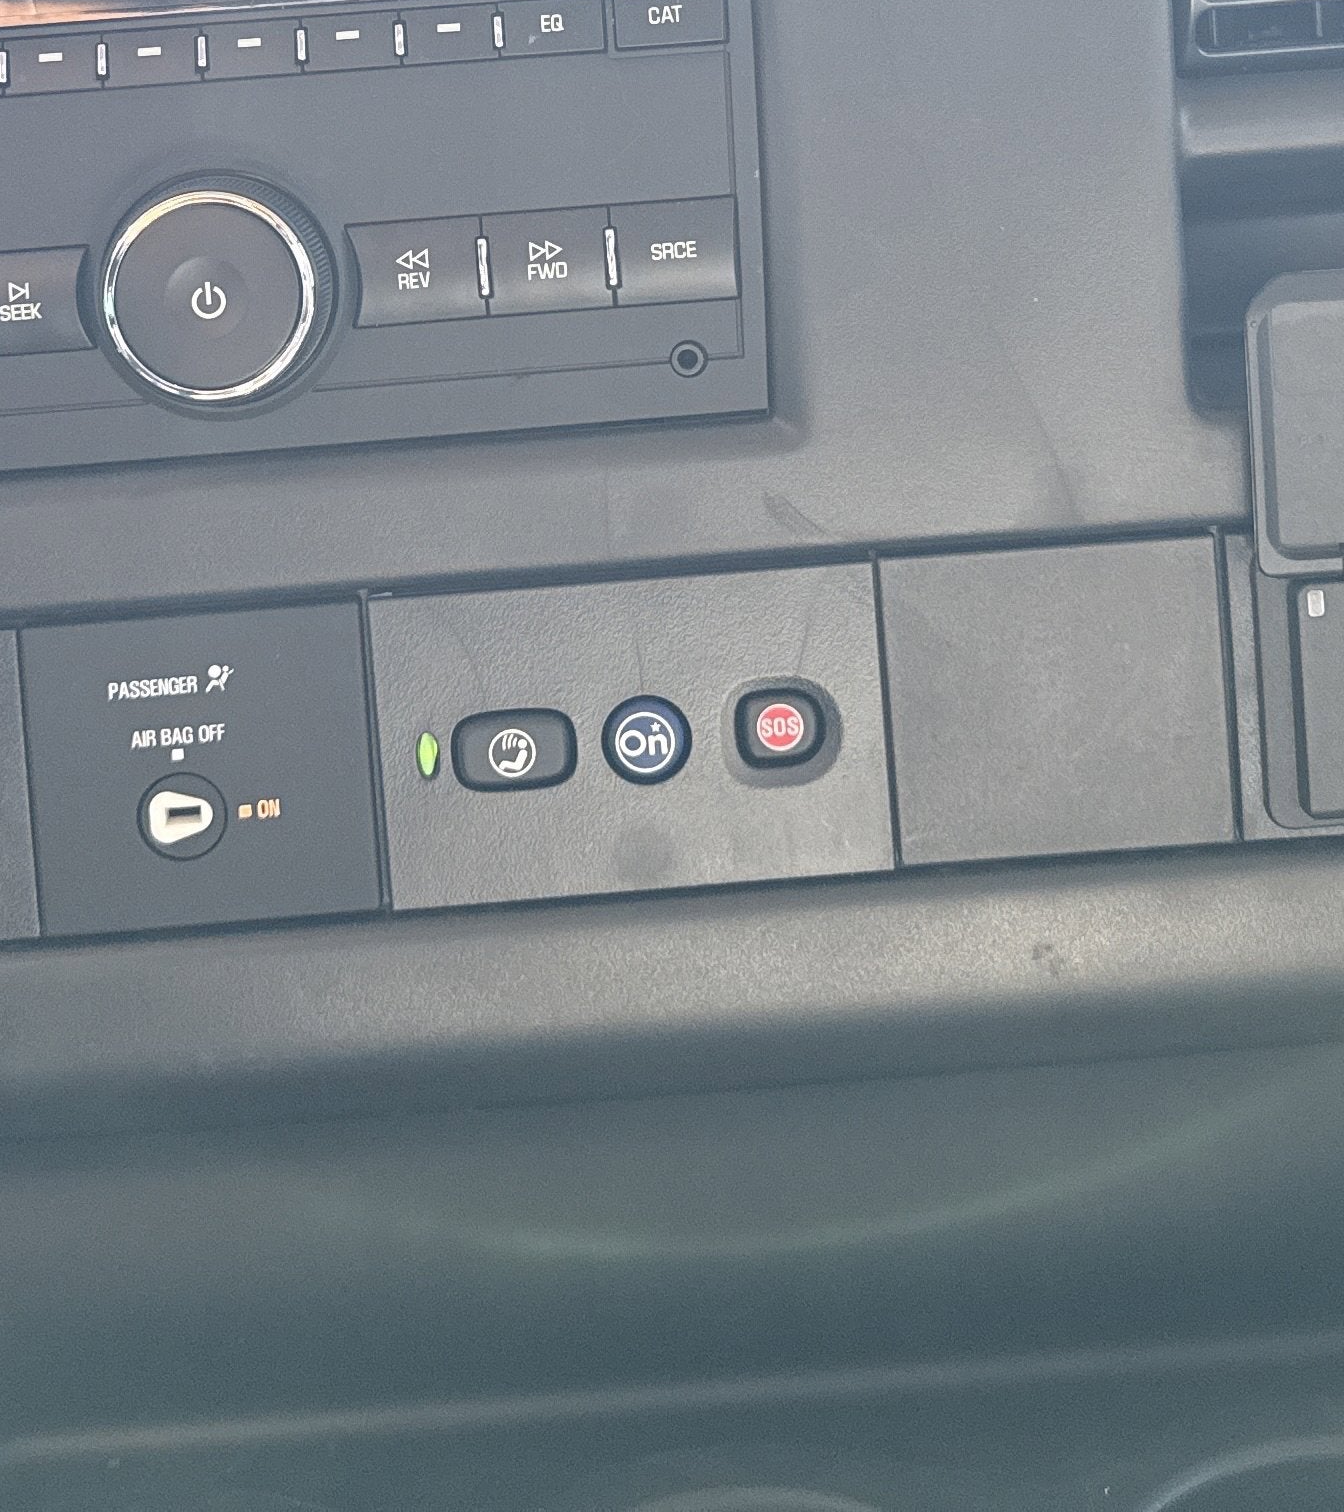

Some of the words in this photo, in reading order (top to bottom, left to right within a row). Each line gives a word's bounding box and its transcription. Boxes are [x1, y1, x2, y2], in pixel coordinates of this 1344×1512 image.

[539, 13, 564, 33] EQ
[647, 4, 683, 25] CAT
[650, 240, 697, 261] SRCE
[397, 271, 430, 290] REV
[527, 261, 568, 281] FWD
[0, 302, 43, 322] SEEK
[107, 675, 199, 701] PASSENGER
[131, 729, 157, 749] AIR
[160, 726, 194, 746] BAG
[198, 723, 226, 743] OFF
[760, 715, 801, 738] SOS
[619, 729, 669, 757] On
[257, 798, 281, 819] ON
